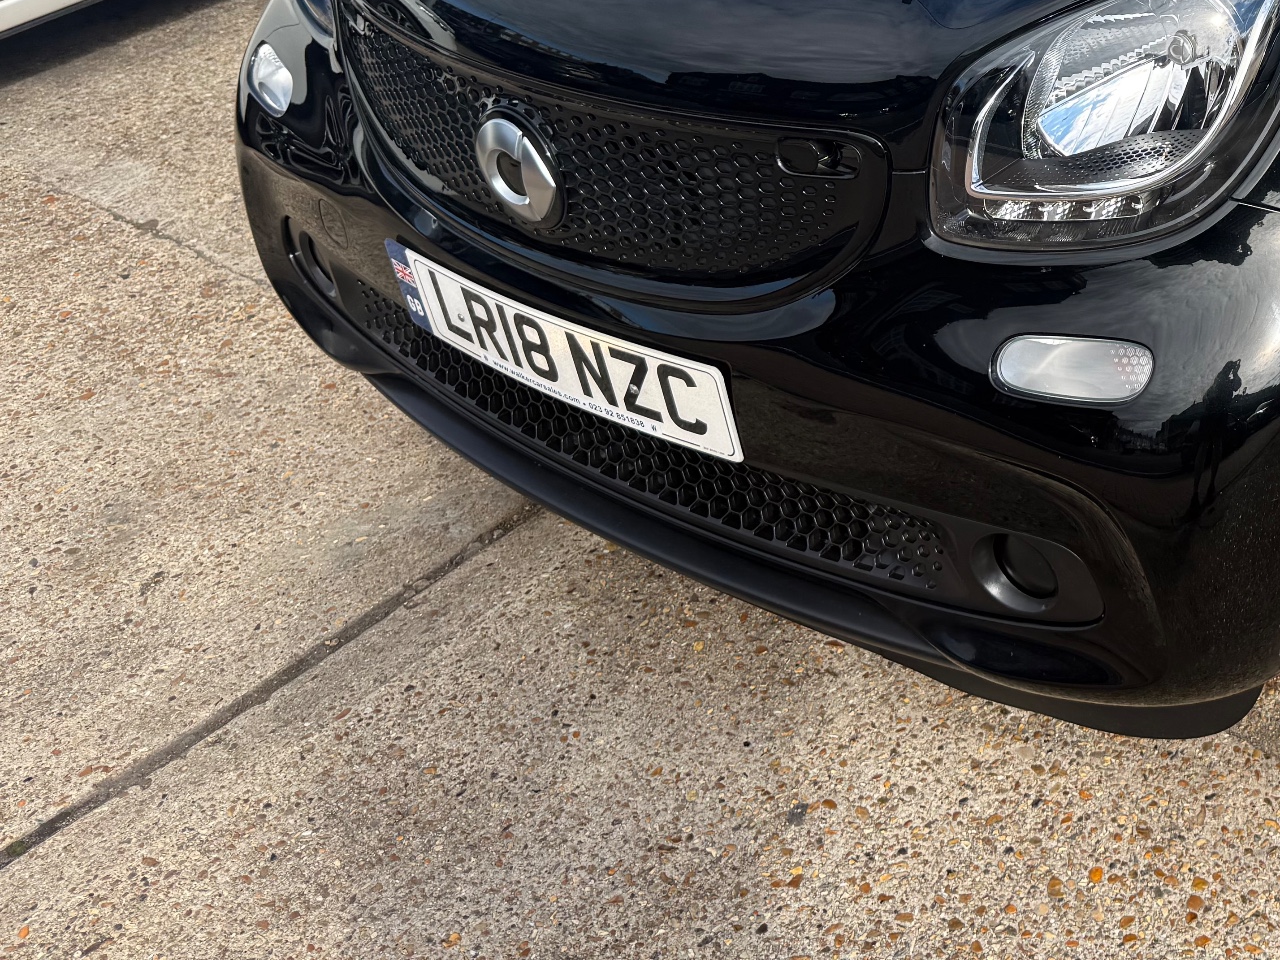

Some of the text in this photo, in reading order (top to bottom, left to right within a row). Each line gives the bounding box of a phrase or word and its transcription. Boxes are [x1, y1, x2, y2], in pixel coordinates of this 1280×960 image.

[406, 294, 426, 318] GB
[428, 269, 708, 436] LR18 NZC
[588, 401, 604, 414] 023
[603, 406, 615, 418] 92
